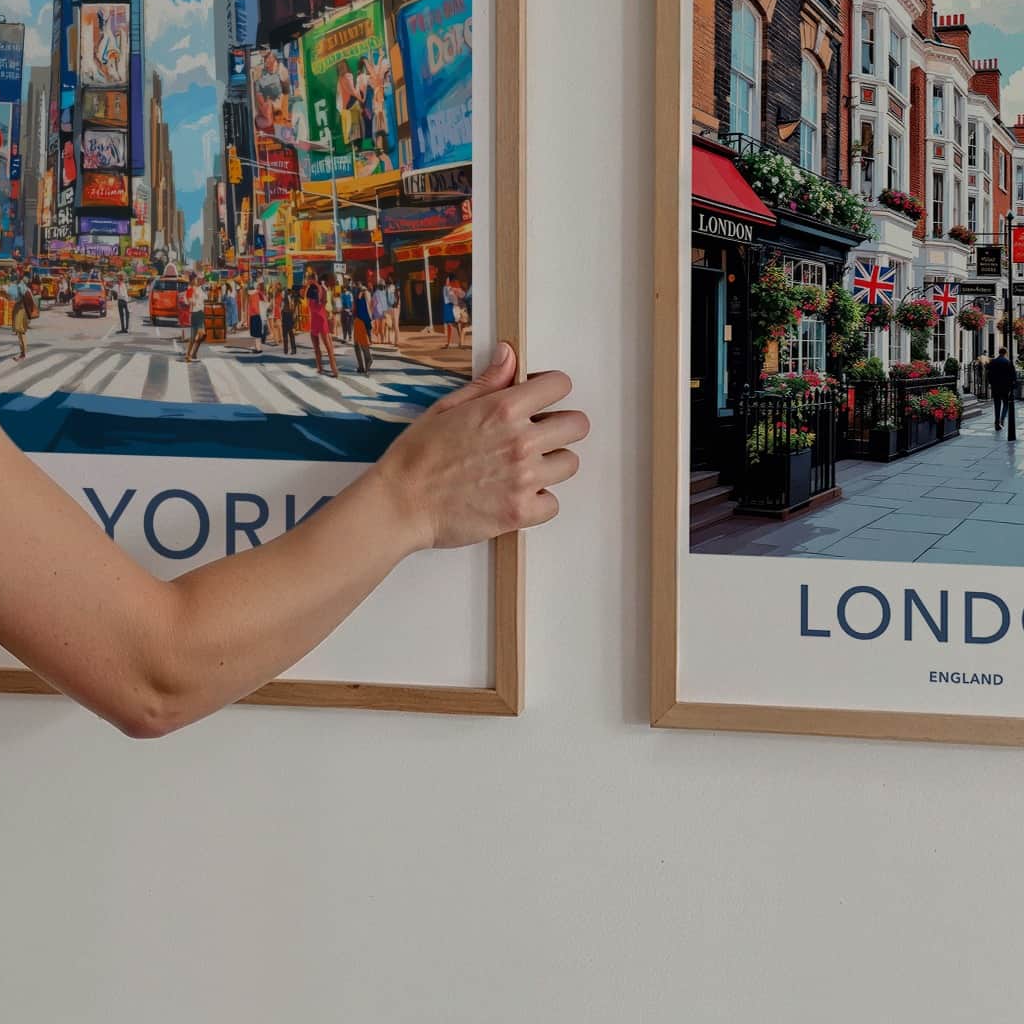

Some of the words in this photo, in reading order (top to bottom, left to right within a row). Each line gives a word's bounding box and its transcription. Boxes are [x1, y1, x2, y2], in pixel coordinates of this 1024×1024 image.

[698, 213, 753, 242] LONDON
[800, 583, 1024, 645] LOND
[928, 671, 1004, 686] ENGLAND
